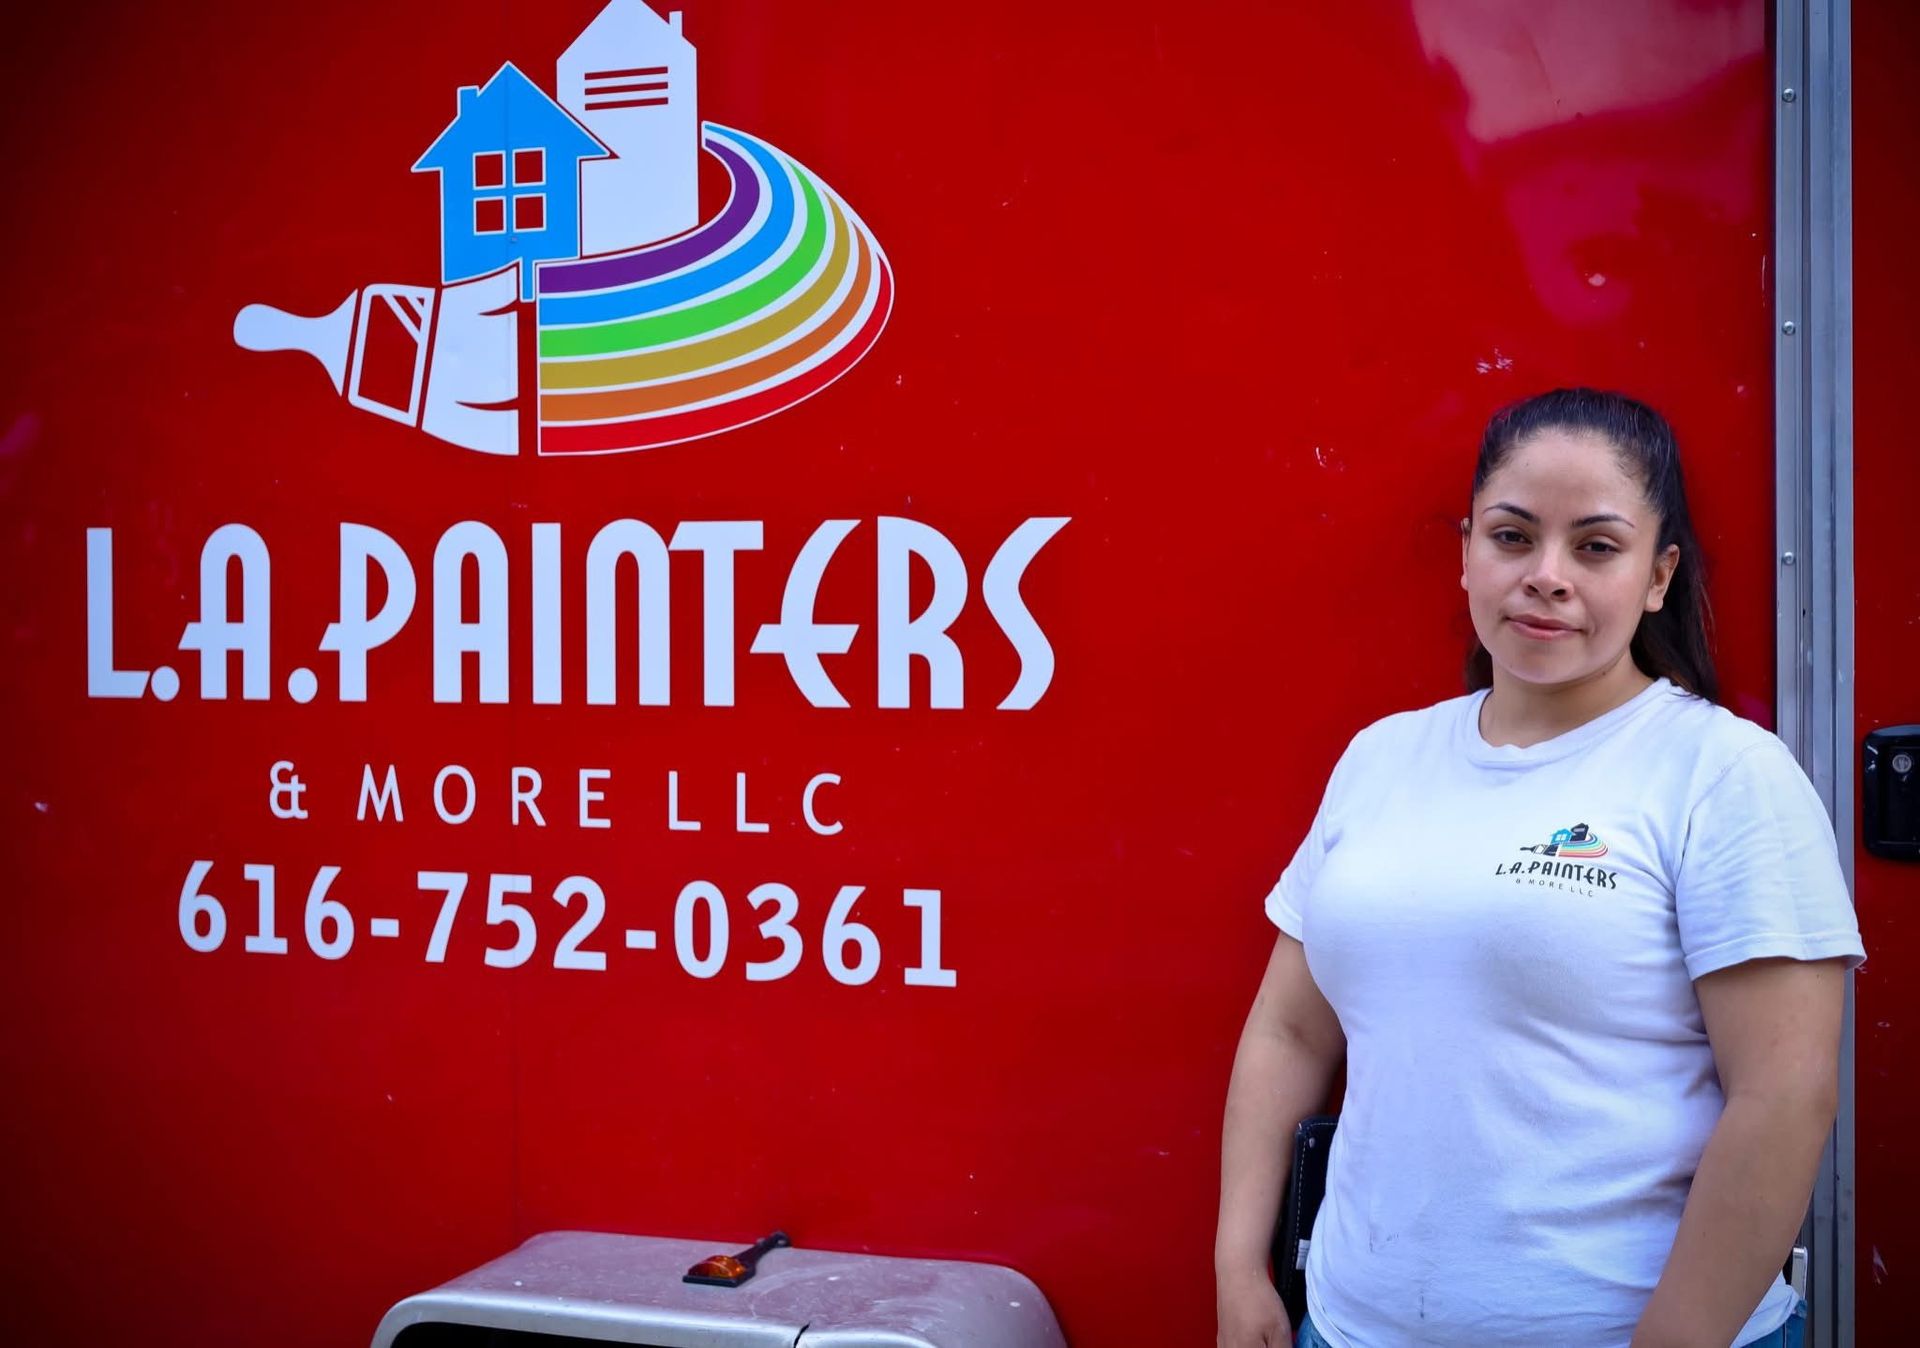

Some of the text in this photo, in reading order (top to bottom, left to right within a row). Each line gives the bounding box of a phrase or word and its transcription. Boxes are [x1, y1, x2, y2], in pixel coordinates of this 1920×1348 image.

[270, 760, 844, 836] & MORE LLC
[1528, 879, 1563, 890] MORE
[178, 860, 957, 988] 616-752-0361
